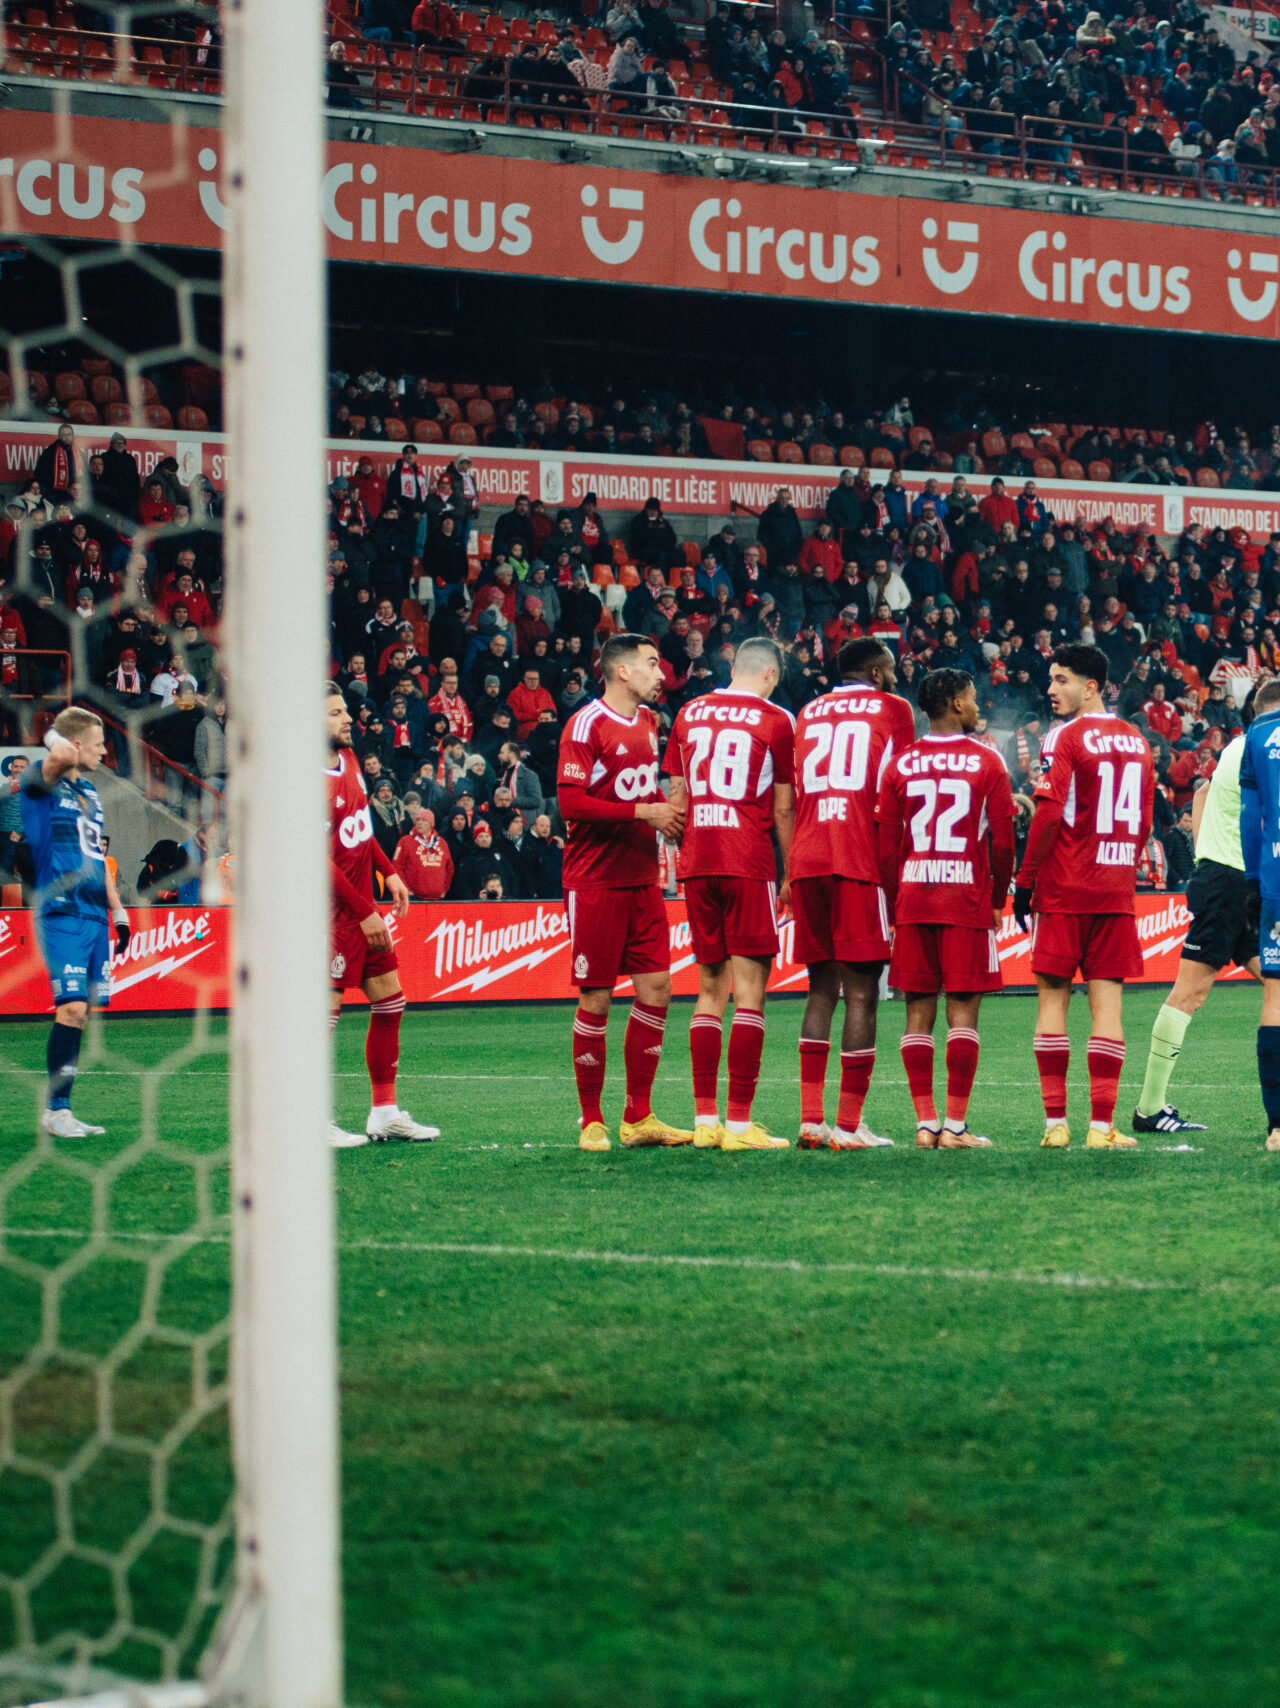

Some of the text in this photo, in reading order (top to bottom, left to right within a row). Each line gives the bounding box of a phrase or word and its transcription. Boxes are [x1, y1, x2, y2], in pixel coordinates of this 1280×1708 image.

[322, 163, 533, 256] Circus
[689, 198, 881, 286] Circus
[1018, 231, 1191, 314] Circus
[571, 473, 649, 500] STANDARD
[652, 477, 672, 502] DE
[675, 475, 717, 504] LIÈGE
[1190, 507, 1250, 531] STANDARD
[1256, 509, 1271, 532] DE
[684, 700, 763, 726] Circus
[803, 698, 883, 720] Circus
[1083, 728, 1146, 754] Circus
[687, 726, 753, 801] 28
[803, 720, 871, 794] 20
[897, 750, 982, 776] Circus
[906, 777, 972, 853] 22
[1096, 761, 1142, 836] 14
[424, 906, 570, 979] Milwaukee
